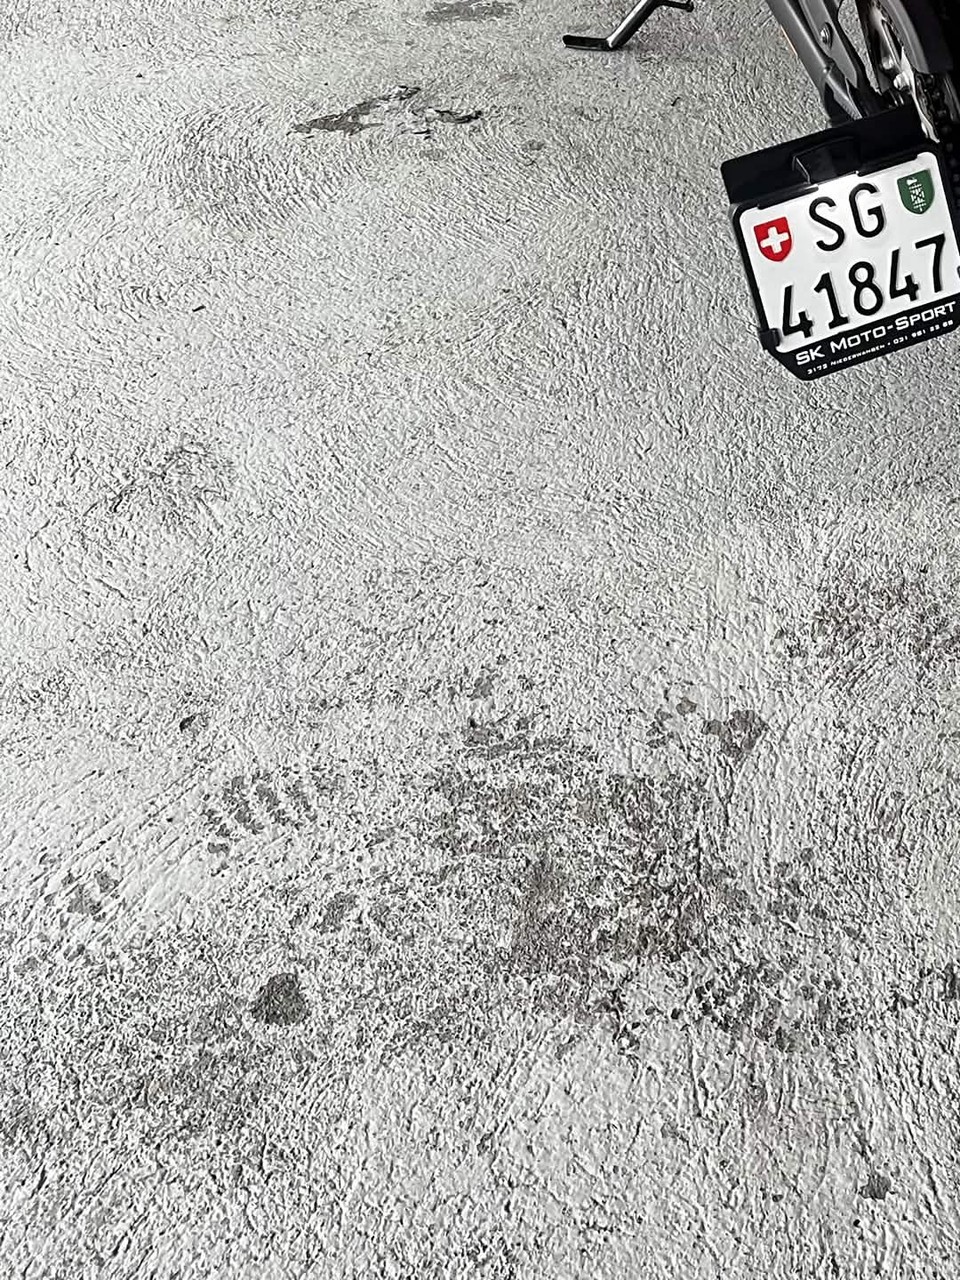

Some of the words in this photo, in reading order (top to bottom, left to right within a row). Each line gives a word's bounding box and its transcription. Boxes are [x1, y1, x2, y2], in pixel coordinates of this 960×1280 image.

[808, 183, 887, 251] SG
[782, 233, 946, 338] 41847
[796, 345, 825, 365] SK
